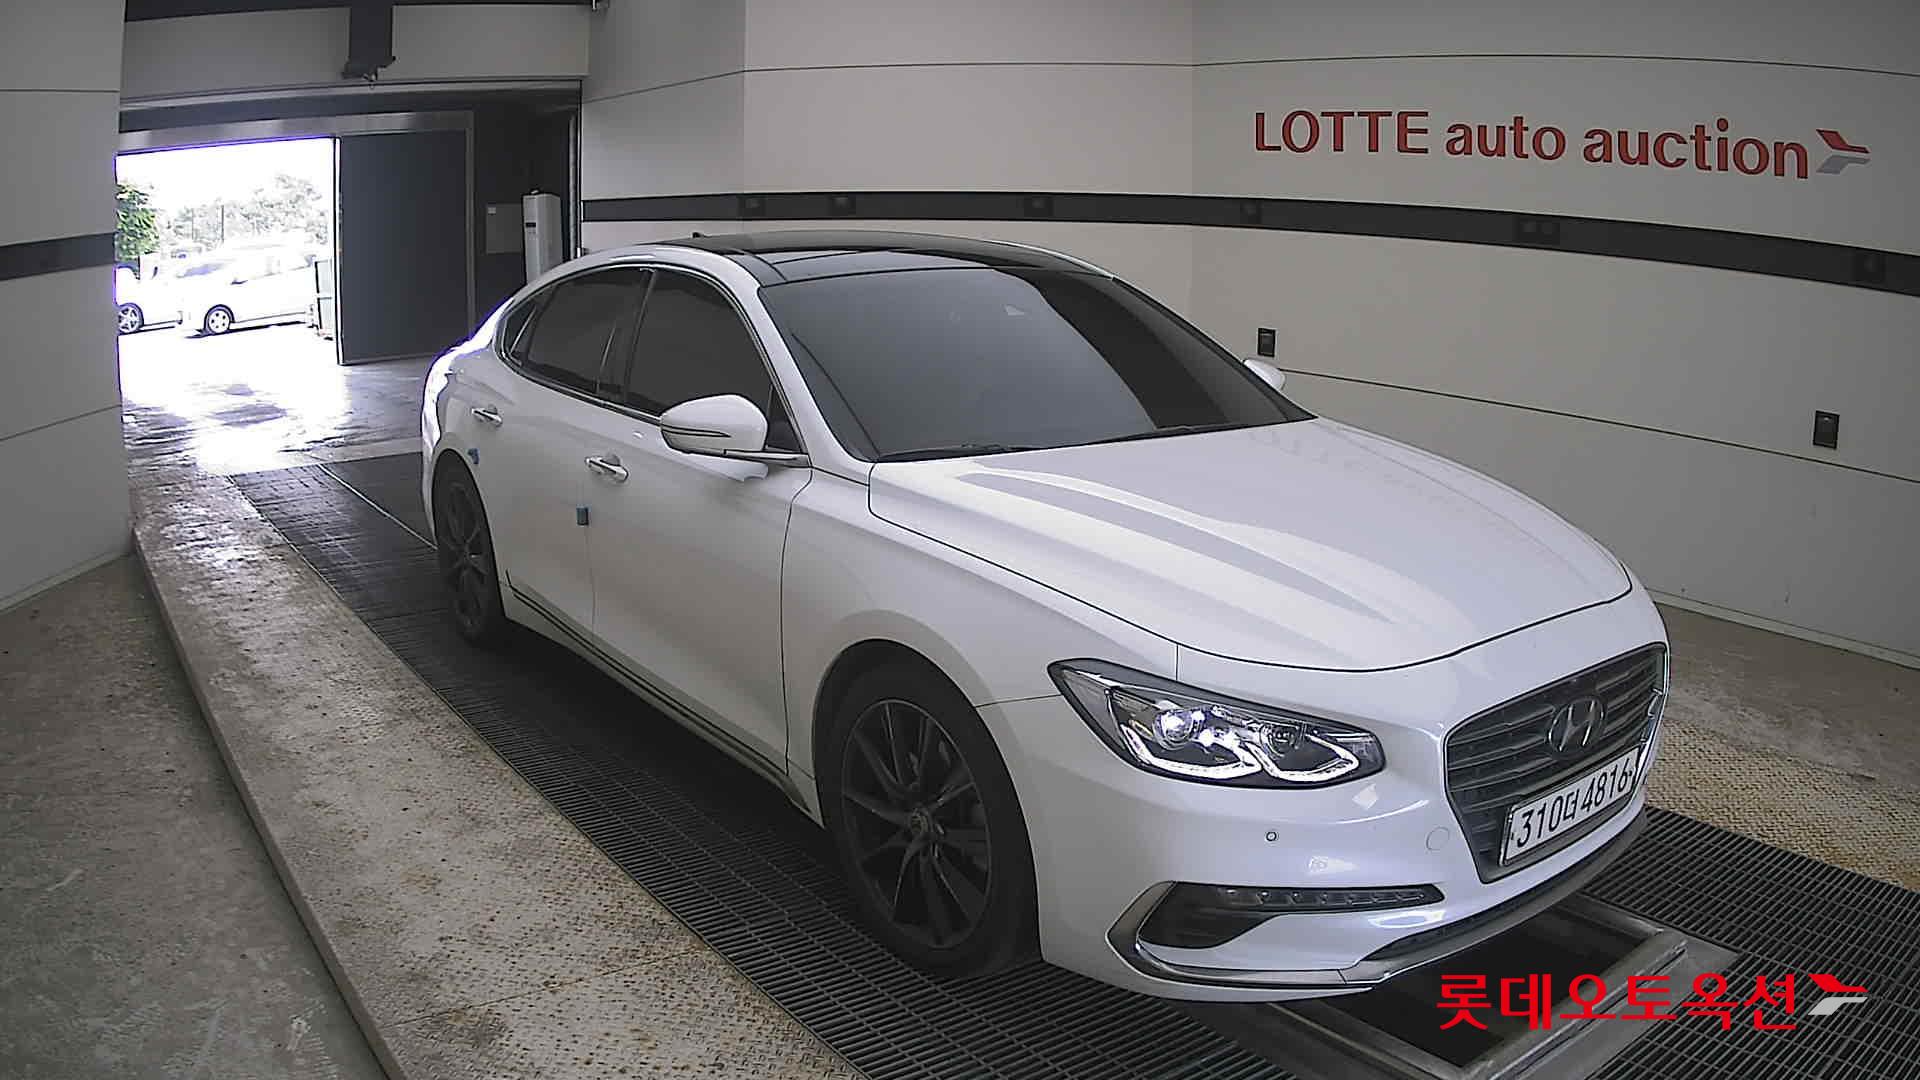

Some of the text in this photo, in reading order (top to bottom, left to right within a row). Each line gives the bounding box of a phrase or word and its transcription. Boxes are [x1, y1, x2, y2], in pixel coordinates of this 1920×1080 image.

[1255, 110, 1809, 180] LOTTE auto auction
